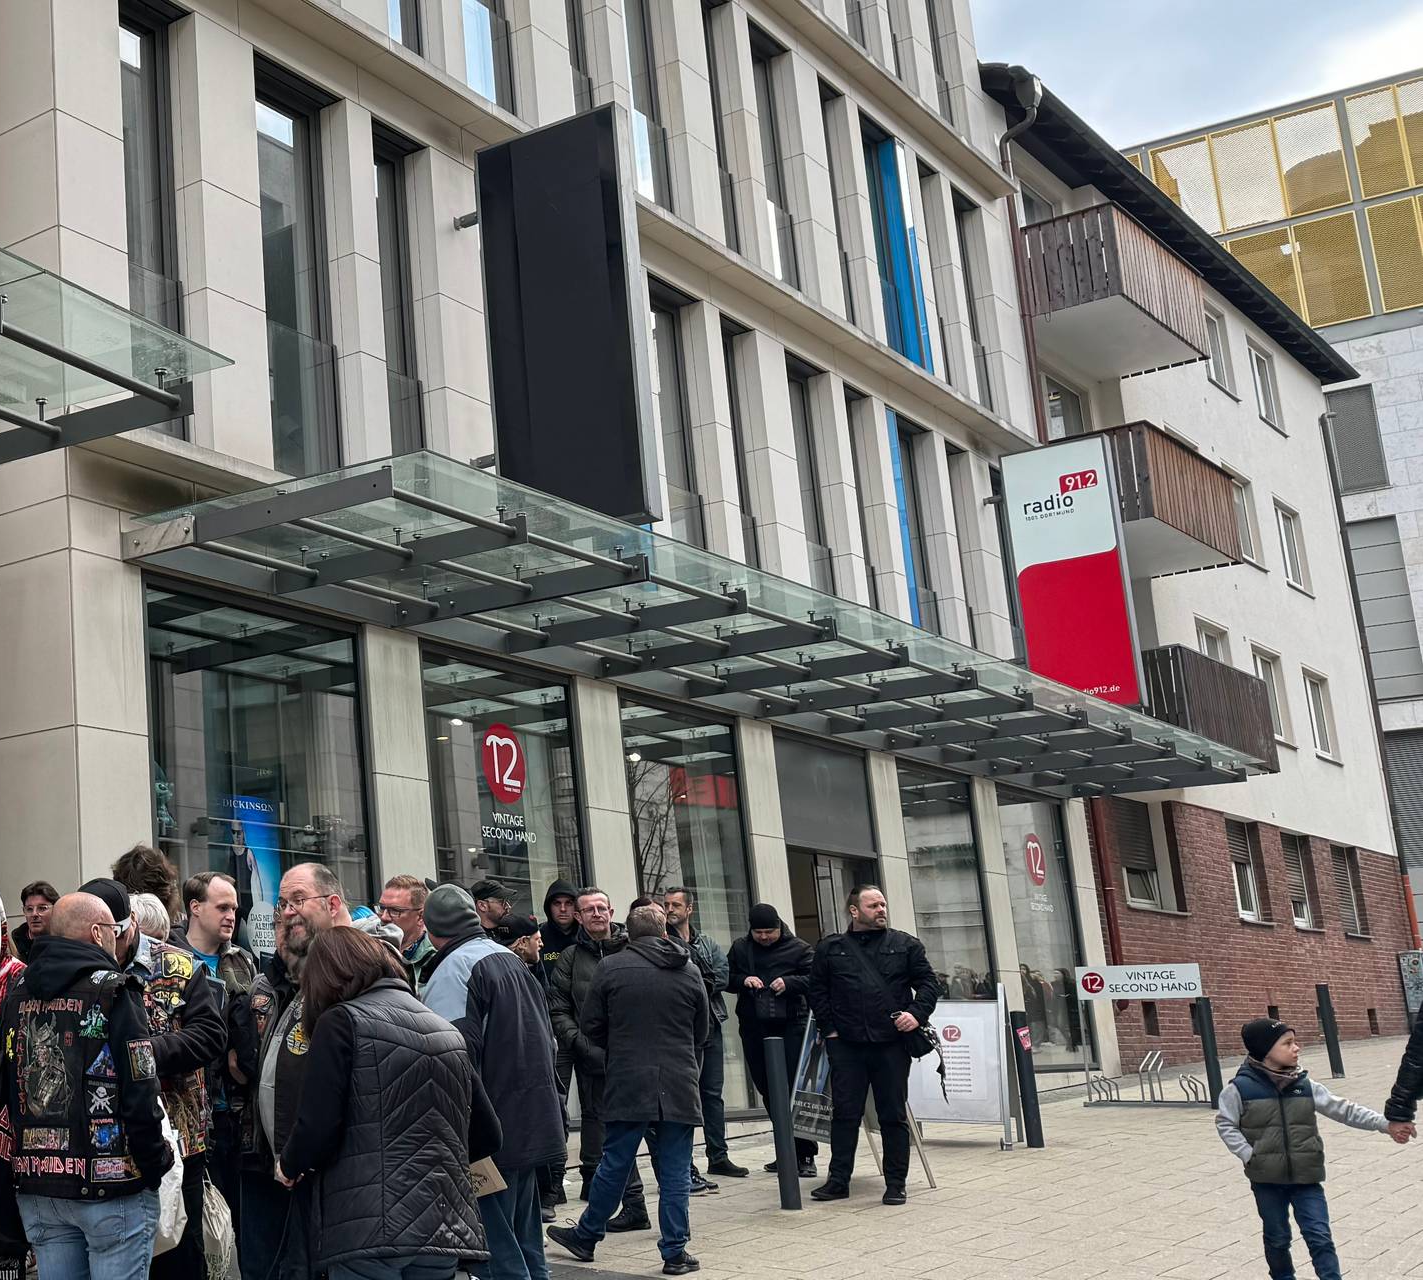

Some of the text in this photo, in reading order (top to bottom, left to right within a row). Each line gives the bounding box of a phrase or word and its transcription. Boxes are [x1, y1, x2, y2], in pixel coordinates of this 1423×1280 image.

[1065, 472, 1096, 491] 91.2
[1023, 493, 1074, 515] radio
[1040, 508, 1075, 519] DORTMUND
[492, 811, 525, 827] VINTAGE
[482, 825, 537, 844] SECOND HAND
[250, 913, 262, 922] DAS
[254, 931, 263, 939] AB
[1125, 970, 1177, 981] VINTAGE
[1109, 982, 1197, 993] SECOND HAND
[31, 1156, 86, 1180] MAIDEN
